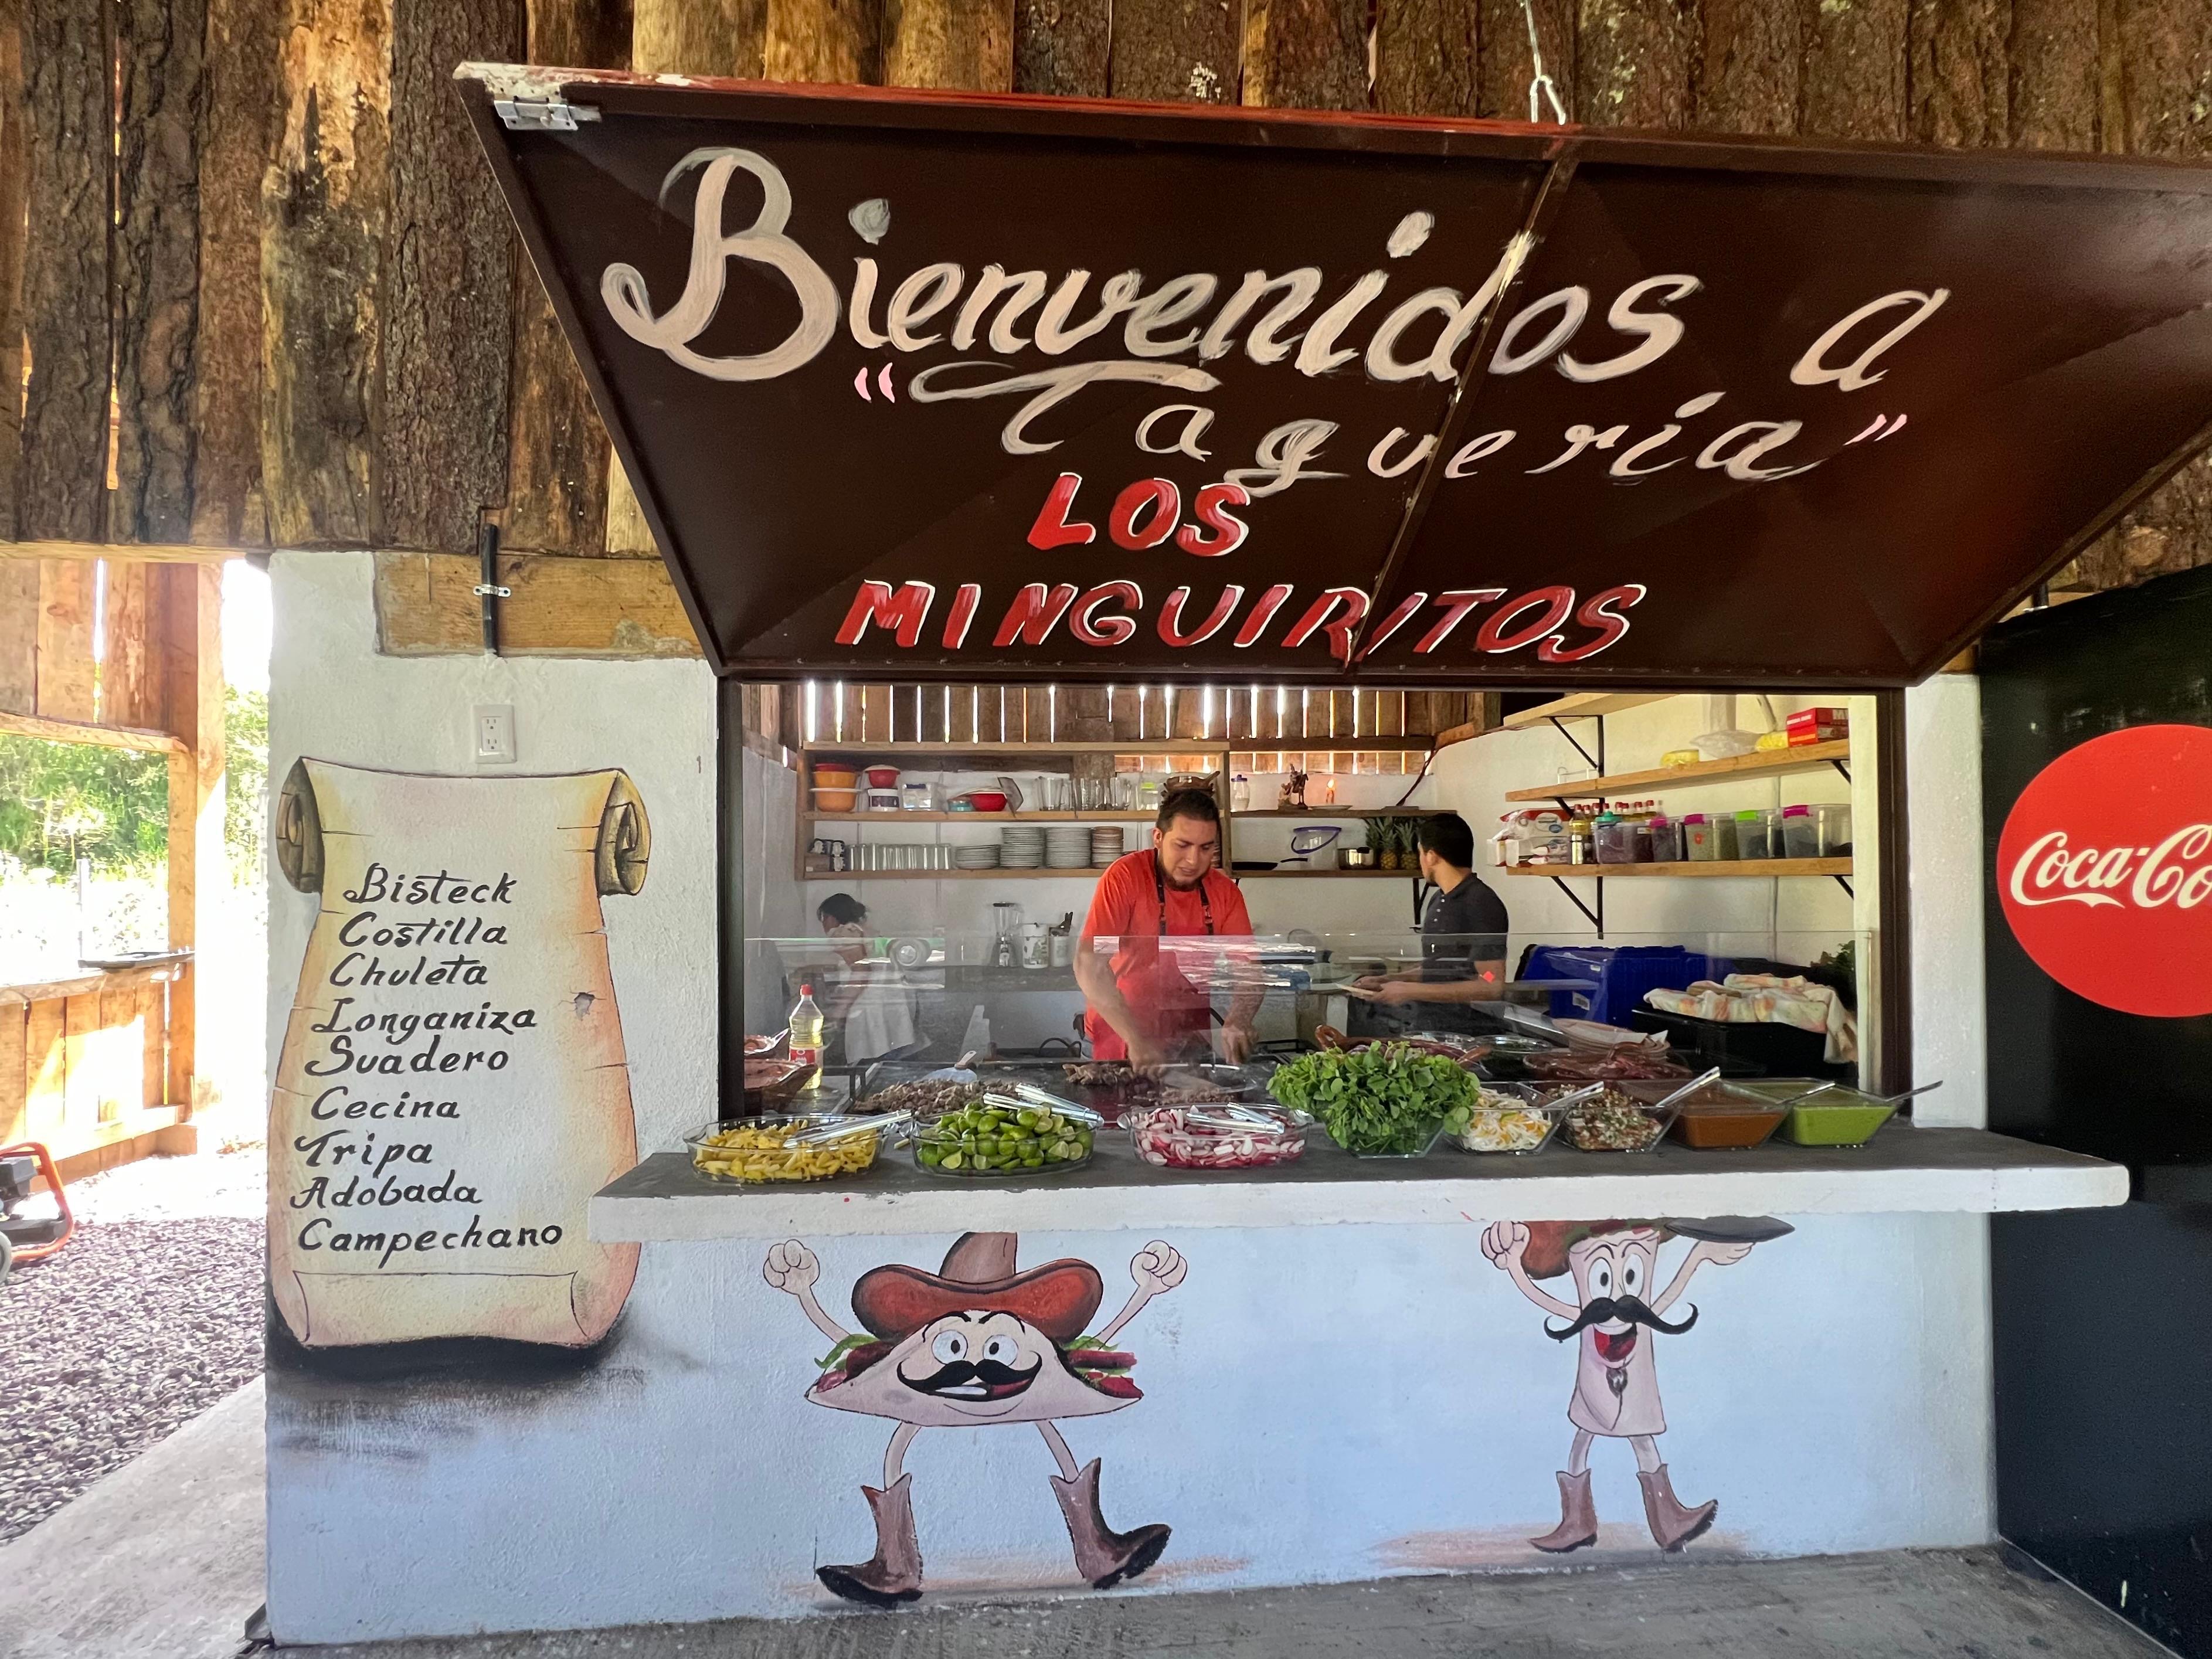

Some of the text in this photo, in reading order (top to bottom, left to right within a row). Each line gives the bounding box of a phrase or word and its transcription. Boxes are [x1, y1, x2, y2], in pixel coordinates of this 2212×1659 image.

[600, 147, 1704, 383] Bienvenidos
[1027, 471, 1250, 557] LOS
[834, 579, 1646, 665] MINGUIRITOS
[343, 862, 517, 905] Bisteck
[338, 911, 508, 947] Costilla
[329, 952, 488, 987] Chuleta
[310, 997, 538, 1045] Longaniza
[304, 1034, 509, 1077] Suadero
[310, 1086, 461, 1120] Cecina
[294, 1130, 433, 1179] Tripa
[290, 1170, 483, 1209] Adobada
[298, 1214, 563, 1269] Campechano
